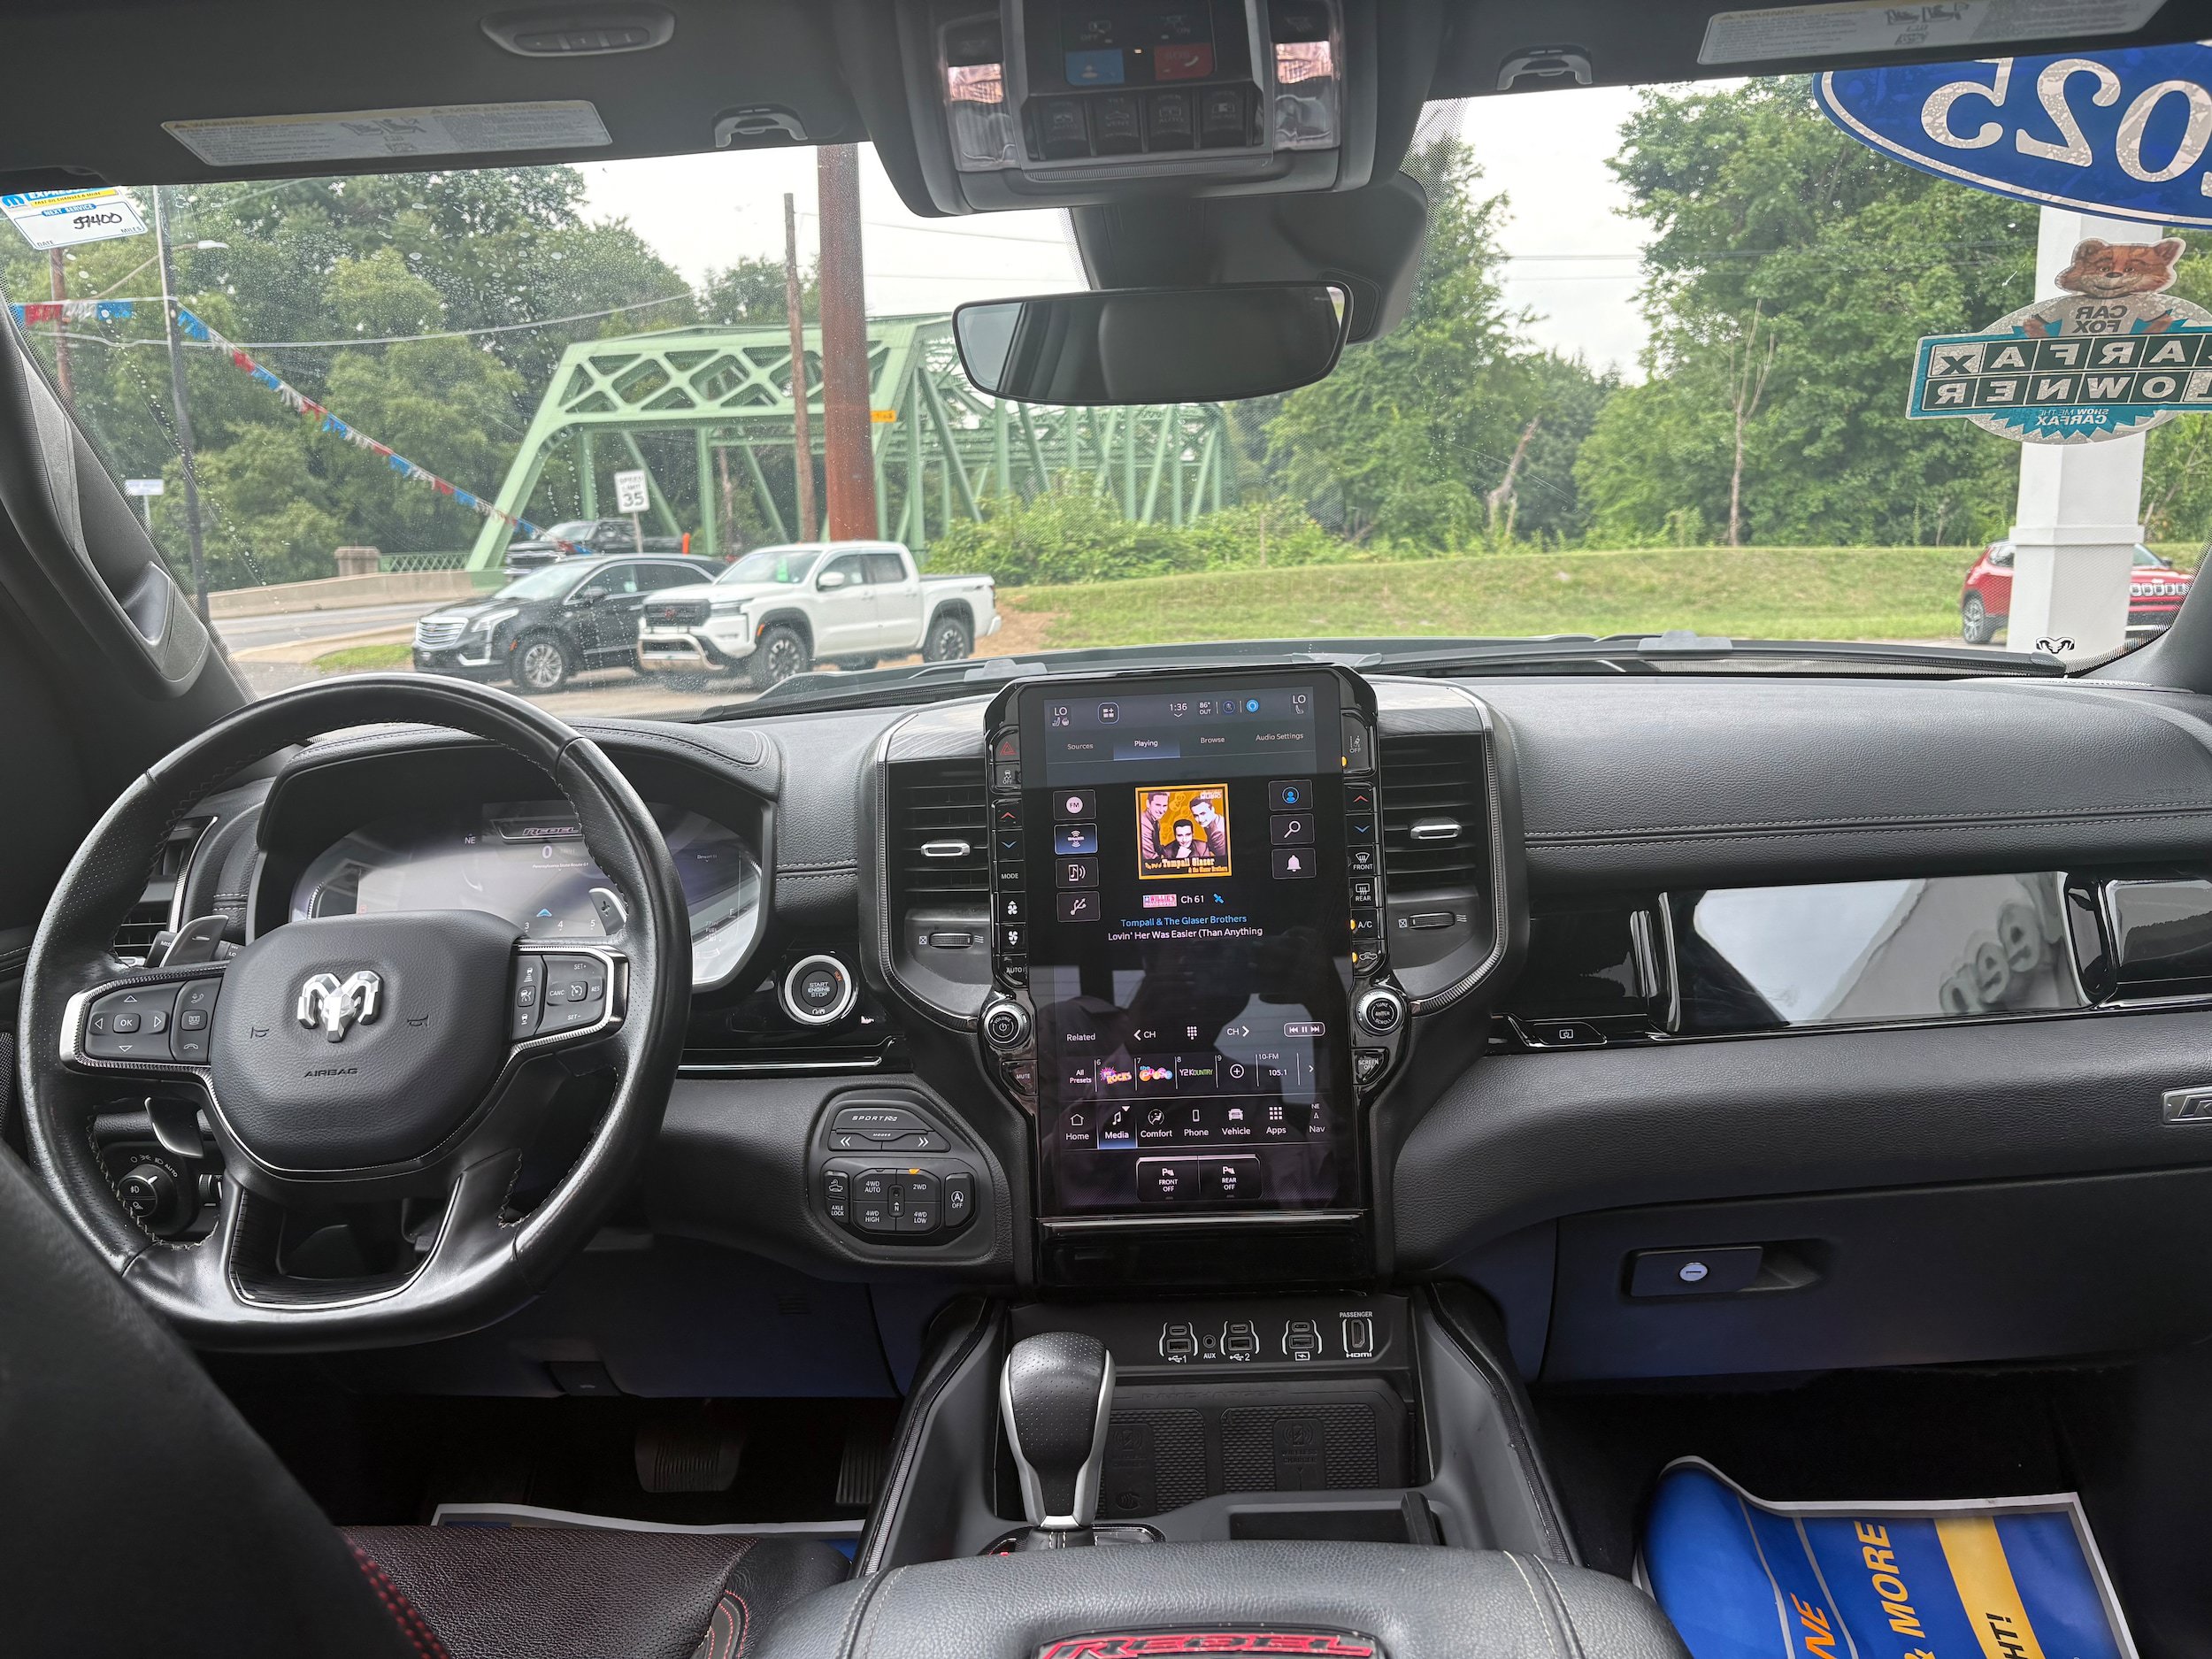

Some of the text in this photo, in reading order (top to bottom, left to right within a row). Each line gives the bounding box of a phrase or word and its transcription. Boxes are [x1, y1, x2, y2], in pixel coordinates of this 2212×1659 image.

[65, 204, 95, 212] SERVICE
[622, 491, 644, 507] 35
[1292, 695, 1306, 704] LO
[1054, 707, 1068, 716] LO
[1194, 895, 1204, 903] 61
[1120, 915, 1248, 927] Tompall & The Glaser Brothers
[1357, 920, 1373, 929] A/C
[1108, 931, 1133, 941] Lovin'
[1134, 931, 1150, 940] Her
[1171, 929, 1196, 938] Easier
[1198, 928, 1223, 938] (Than
[1224, 927, 1263, 938] Anything
[303, 1067, 358, 1078] AIRBAG
[1141, 1129, 1173, 1138] Comfort
[1222, 1126, 1251, 1135] Vehicle
[1266, 1125, 1286, 1134] Apps
[165, 1164, 178, 1178] AUTO
[1854, 1520, 1926, 1639] MORE
